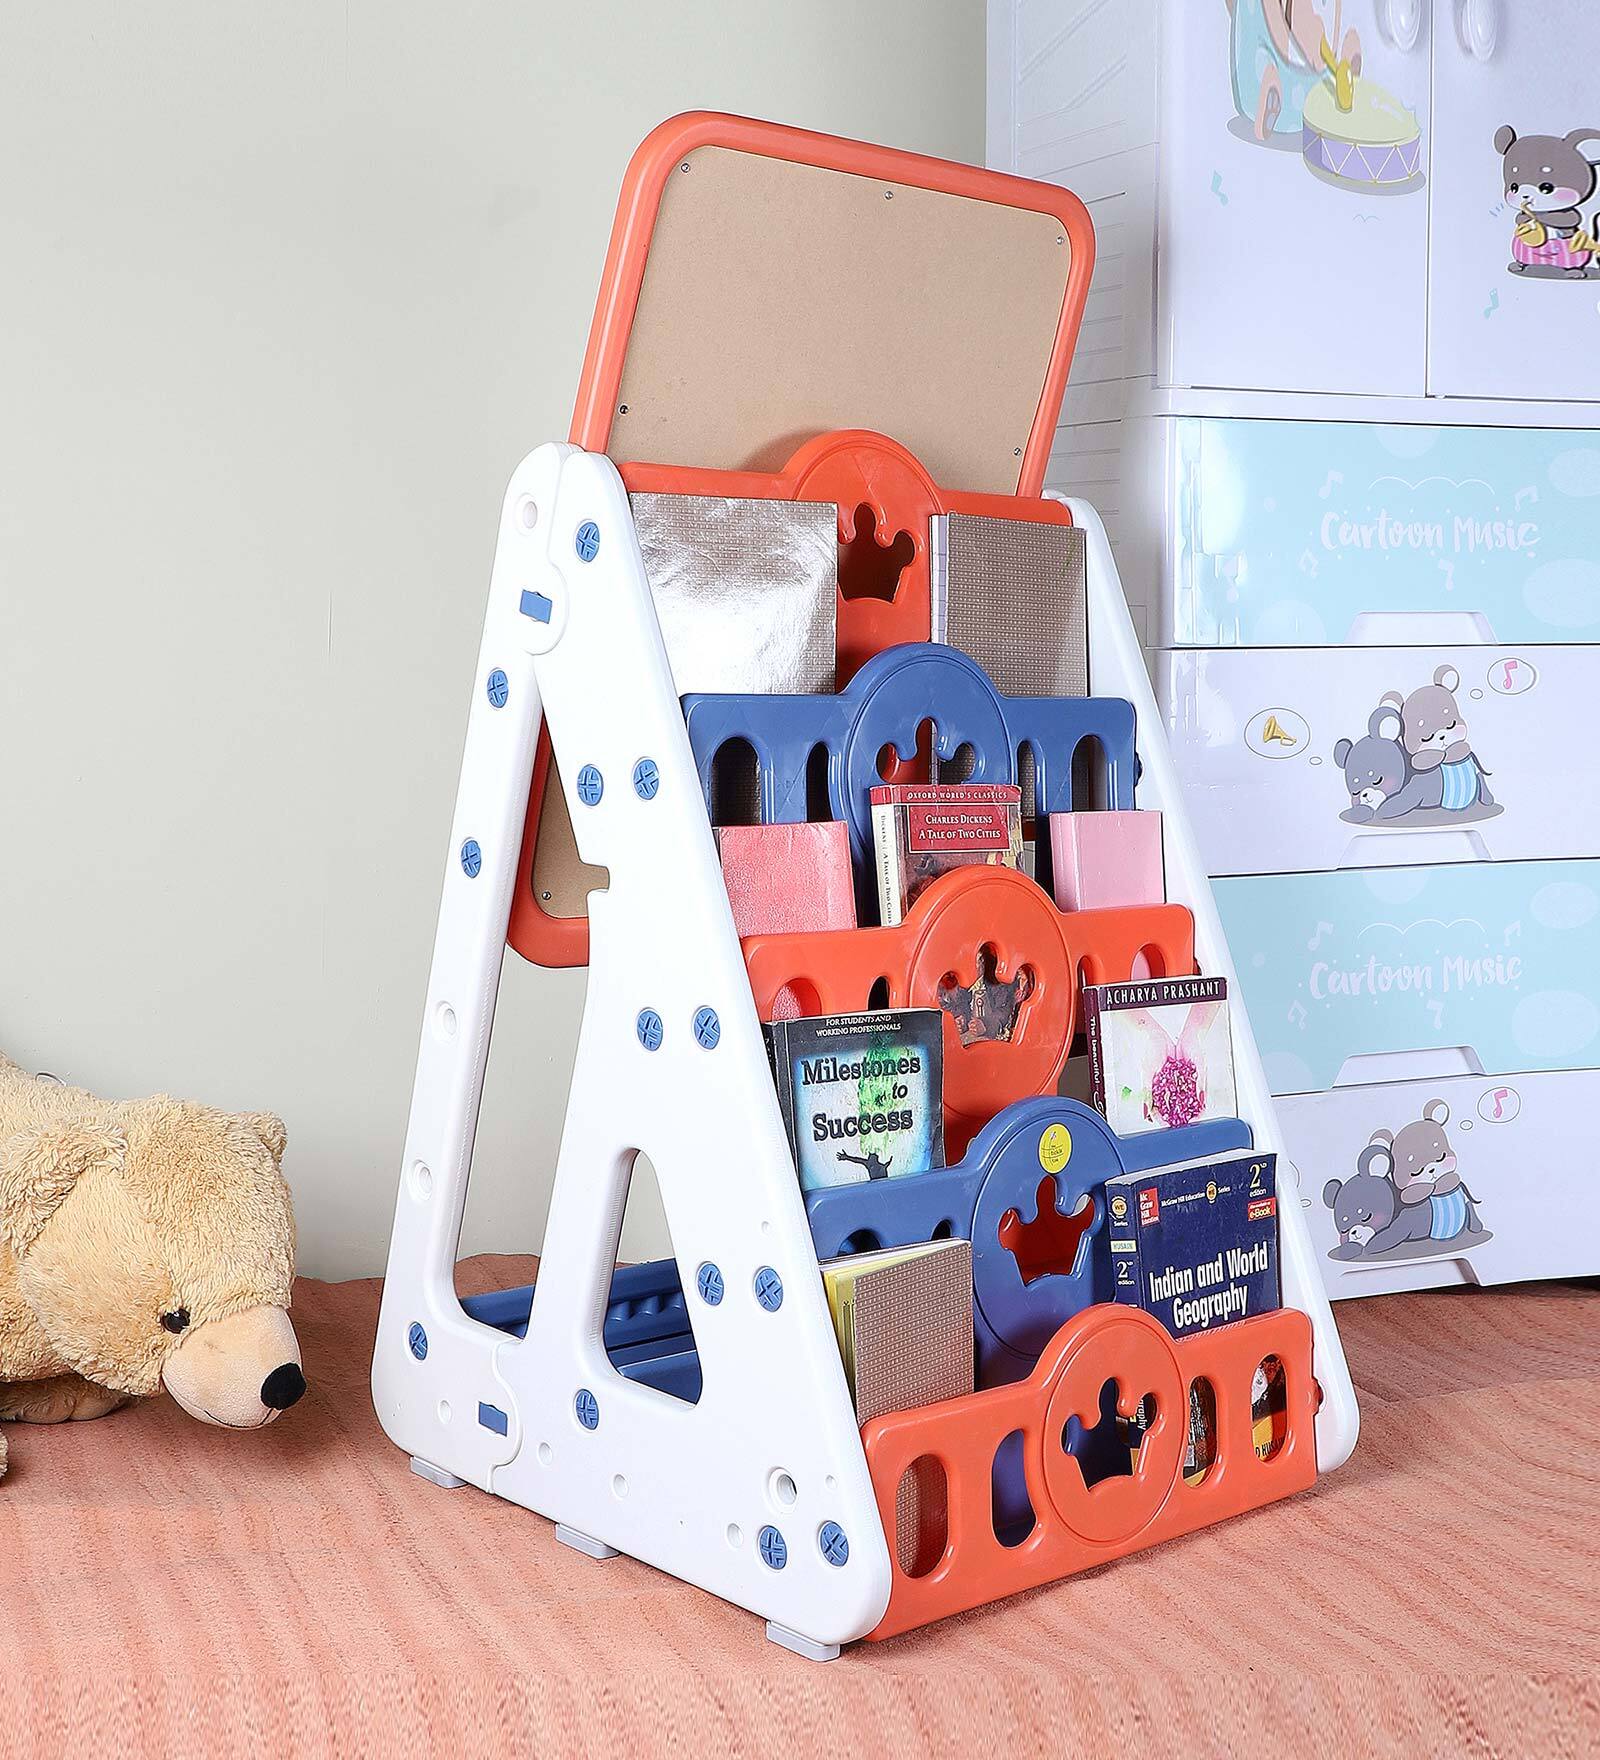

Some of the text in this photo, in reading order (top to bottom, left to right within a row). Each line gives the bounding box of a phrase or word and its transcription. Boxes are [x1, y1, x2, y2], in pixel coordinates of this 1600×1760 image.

[1320, 507, 1542, 552] Cartoon Music
[907, 791, 1008, 800] OXFORD WORLD'S CLASSICS
[925, 814, 993, 825] CHARLES DICKENS
[918, 828, 1001, 840] A TALE OF TWO CITIES
[1309, 954, 1522, 1000] Cartoon Music
[1106, 981, 1220, 1005] ACHARYA PRASHANT
[826, 1018, 840, 1026] FOR
[840, 1016, 875, 1025] STUDENTS
[816, 1023, 901, 1037] WORKING PROFESSIONALS
[800, 1056, 921, 1086] Milestones
[892, 1082, 909, 1099] to
[812, 1109, 914, 1141] Success
[1185, 1192, 1206, 1201] Education
[1249, 1188, 1267, 1198] edition
[1140, 1201, 1154, 1210] Graw
[1249, 1206, 1271, 1219] e-Book
[1149, 1240, 1269, 1302] Indian and World
[1173, 1281, 1248, 1329] Geography
